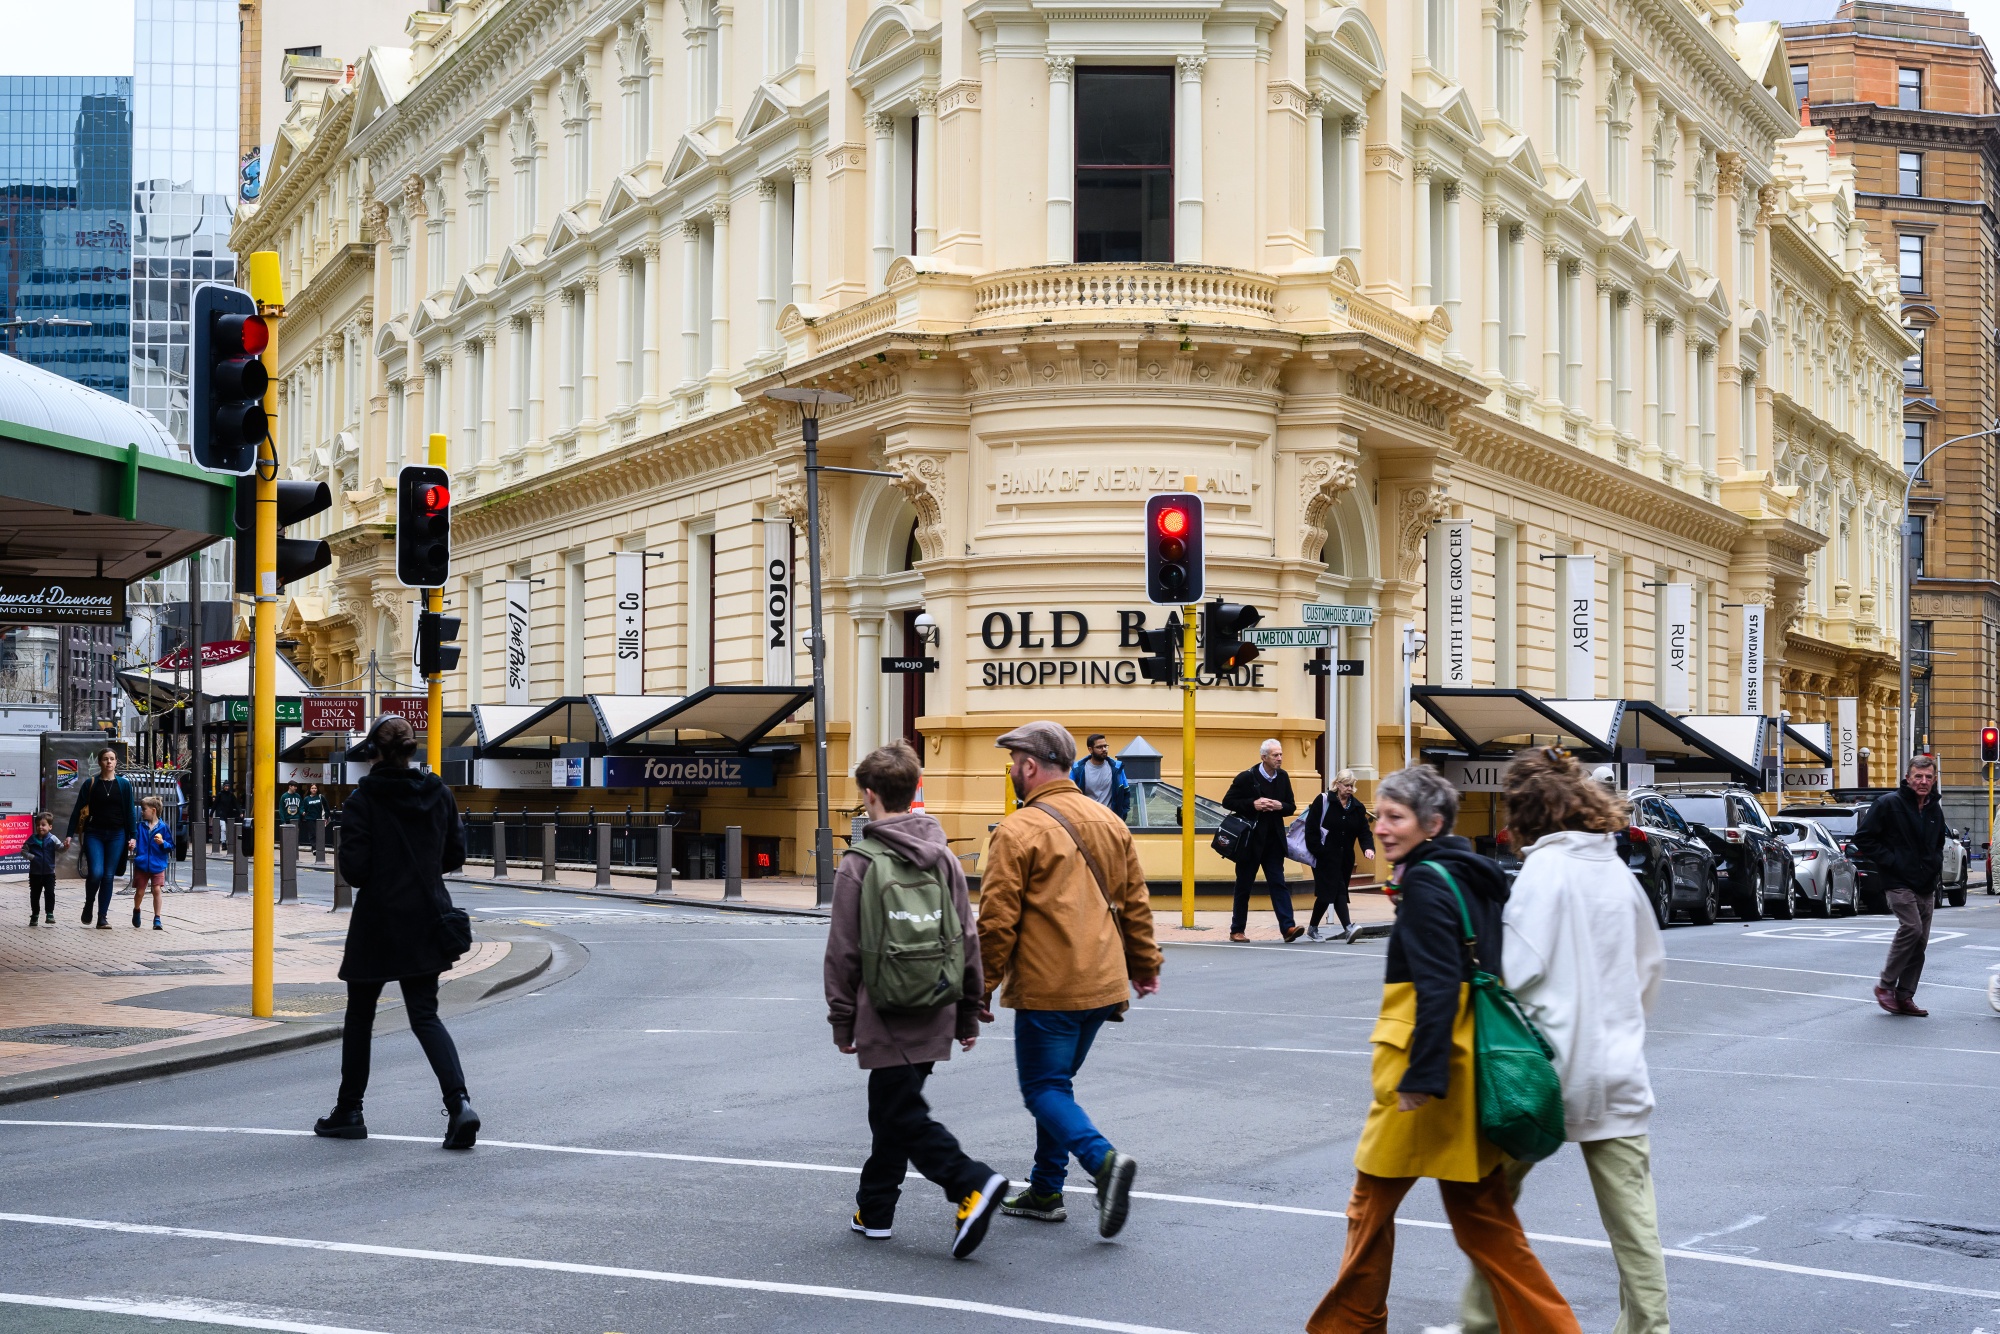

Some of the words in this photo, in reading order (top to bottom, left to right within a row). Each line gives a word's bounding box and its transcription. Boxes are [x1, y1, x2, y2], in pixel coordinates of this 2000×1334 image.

[1388, 391, 1407, 417] NEW
[1000, 467, 1054, 494] BANK
[1059, 466, 1089, 491] OF
[1093, 466, 1144, 491] NEW
[1450, 528, 1463, 590] GROCER
[0, 586, 46, 604] ewart
[46, 586, 112, 605] Dawsons
[618, 593, 639, 610] Co
[769, 559, 788, 650] MOJO
[57, 608, 113, 616] WATCHES
[510, 601, 527, 614] I
[1306, 606, 1348, 622] CUSTOMHOUSE
[1350, 608, 1367, 623] QUAY
[1451, 595, 1463, 626] THE
[509, 613, 527, 646] Love
[625, 616, 635, 624] +
[981, 610, 1089, 649] OLD
[1573, 599, 1588, 653] RUBY
[618, 630, 639, 659] Sills
[1250, 631, 1293, 645] LAMBTON
[1297, 630, 1321, 644] QUAY
[1748, 614, 1758, 674] STANDARD
[202, 644, 243, 660] BANK
[1451, 629, 1463, 681] SMITH
[1671, 624, 1685, 672] RUBY
[894, 661, 923, 669] MOJO
[982, 660, 1137, 687] SHOPPING
[1322, 664, 1351, 672] MJO
[1747, 677, 1757, 711] ISSUE
[321, 708, 344, 718] BNZ
[400, 700, 423, 710] THE
[408, 710, 429, 719] BAN
[312, 718, 356, 728] CENTRE
[1841, 727, 1855, 767] taylor
[536, 761, 552, 769] JEW
[644, 758, 741, 779] fonebitz
[1784, 774, 1828, 786] CADE
[889, 911, 921, 923] NIKE
